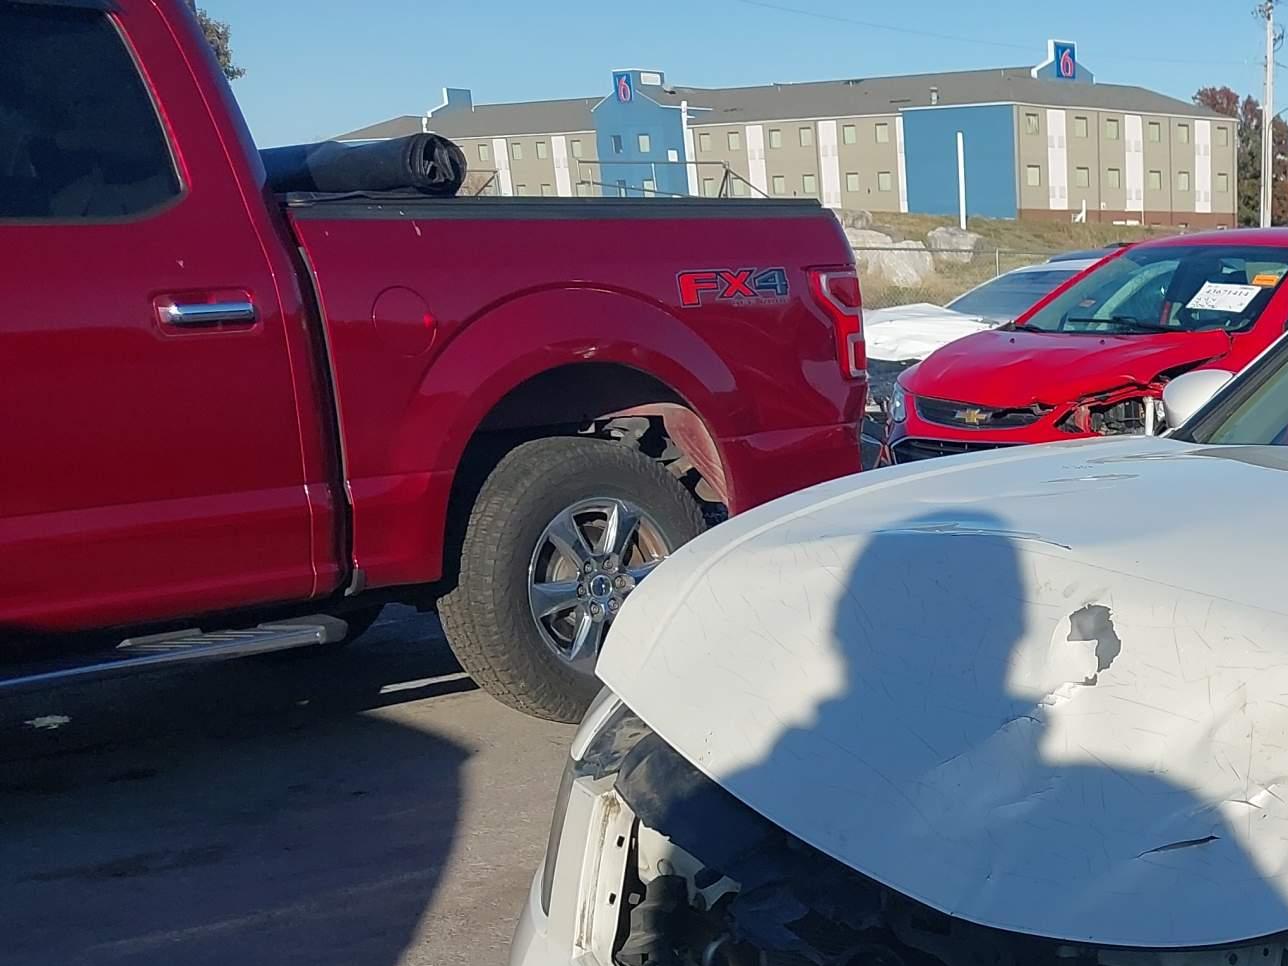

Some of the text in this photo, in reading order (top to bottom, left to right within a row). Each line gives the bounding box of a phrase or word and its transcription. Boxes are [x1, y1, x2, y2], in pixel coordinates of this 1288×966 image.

[1060, 48, 1074, 77] 6
[617, 75, 631, 103] 6
[676, 266, 791, 308] FX4
